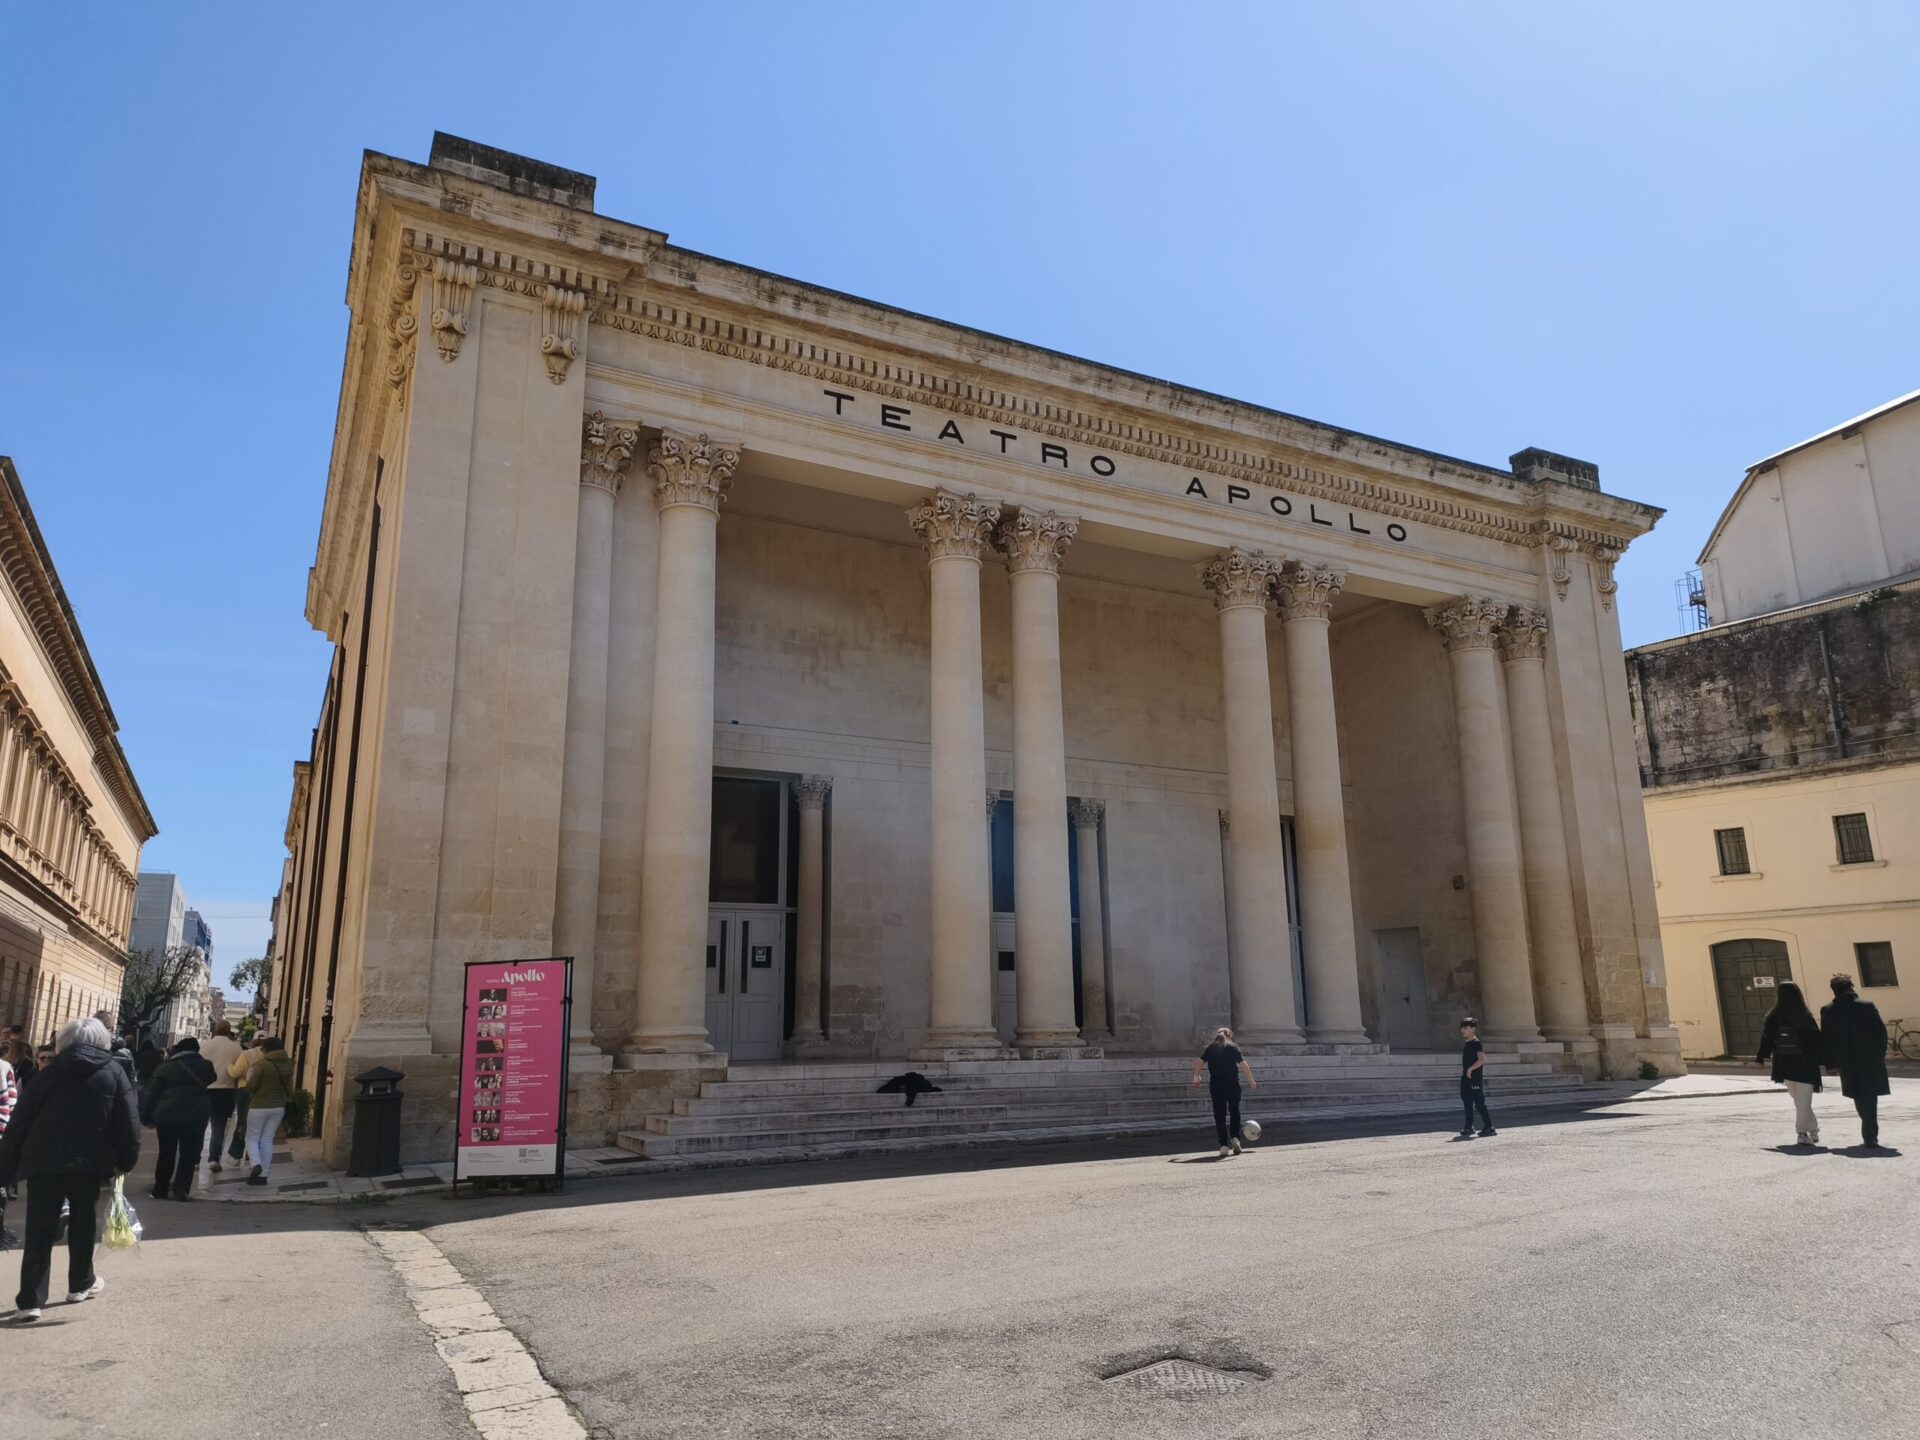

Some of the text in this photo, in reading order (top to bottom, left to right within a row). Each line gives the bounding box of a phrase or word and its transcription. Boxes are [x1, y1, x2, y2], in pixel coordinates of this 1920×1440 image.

[823, 389, 1407, 542] TEATRO APOLLO
[501, 969, 545, 985] Apollo
